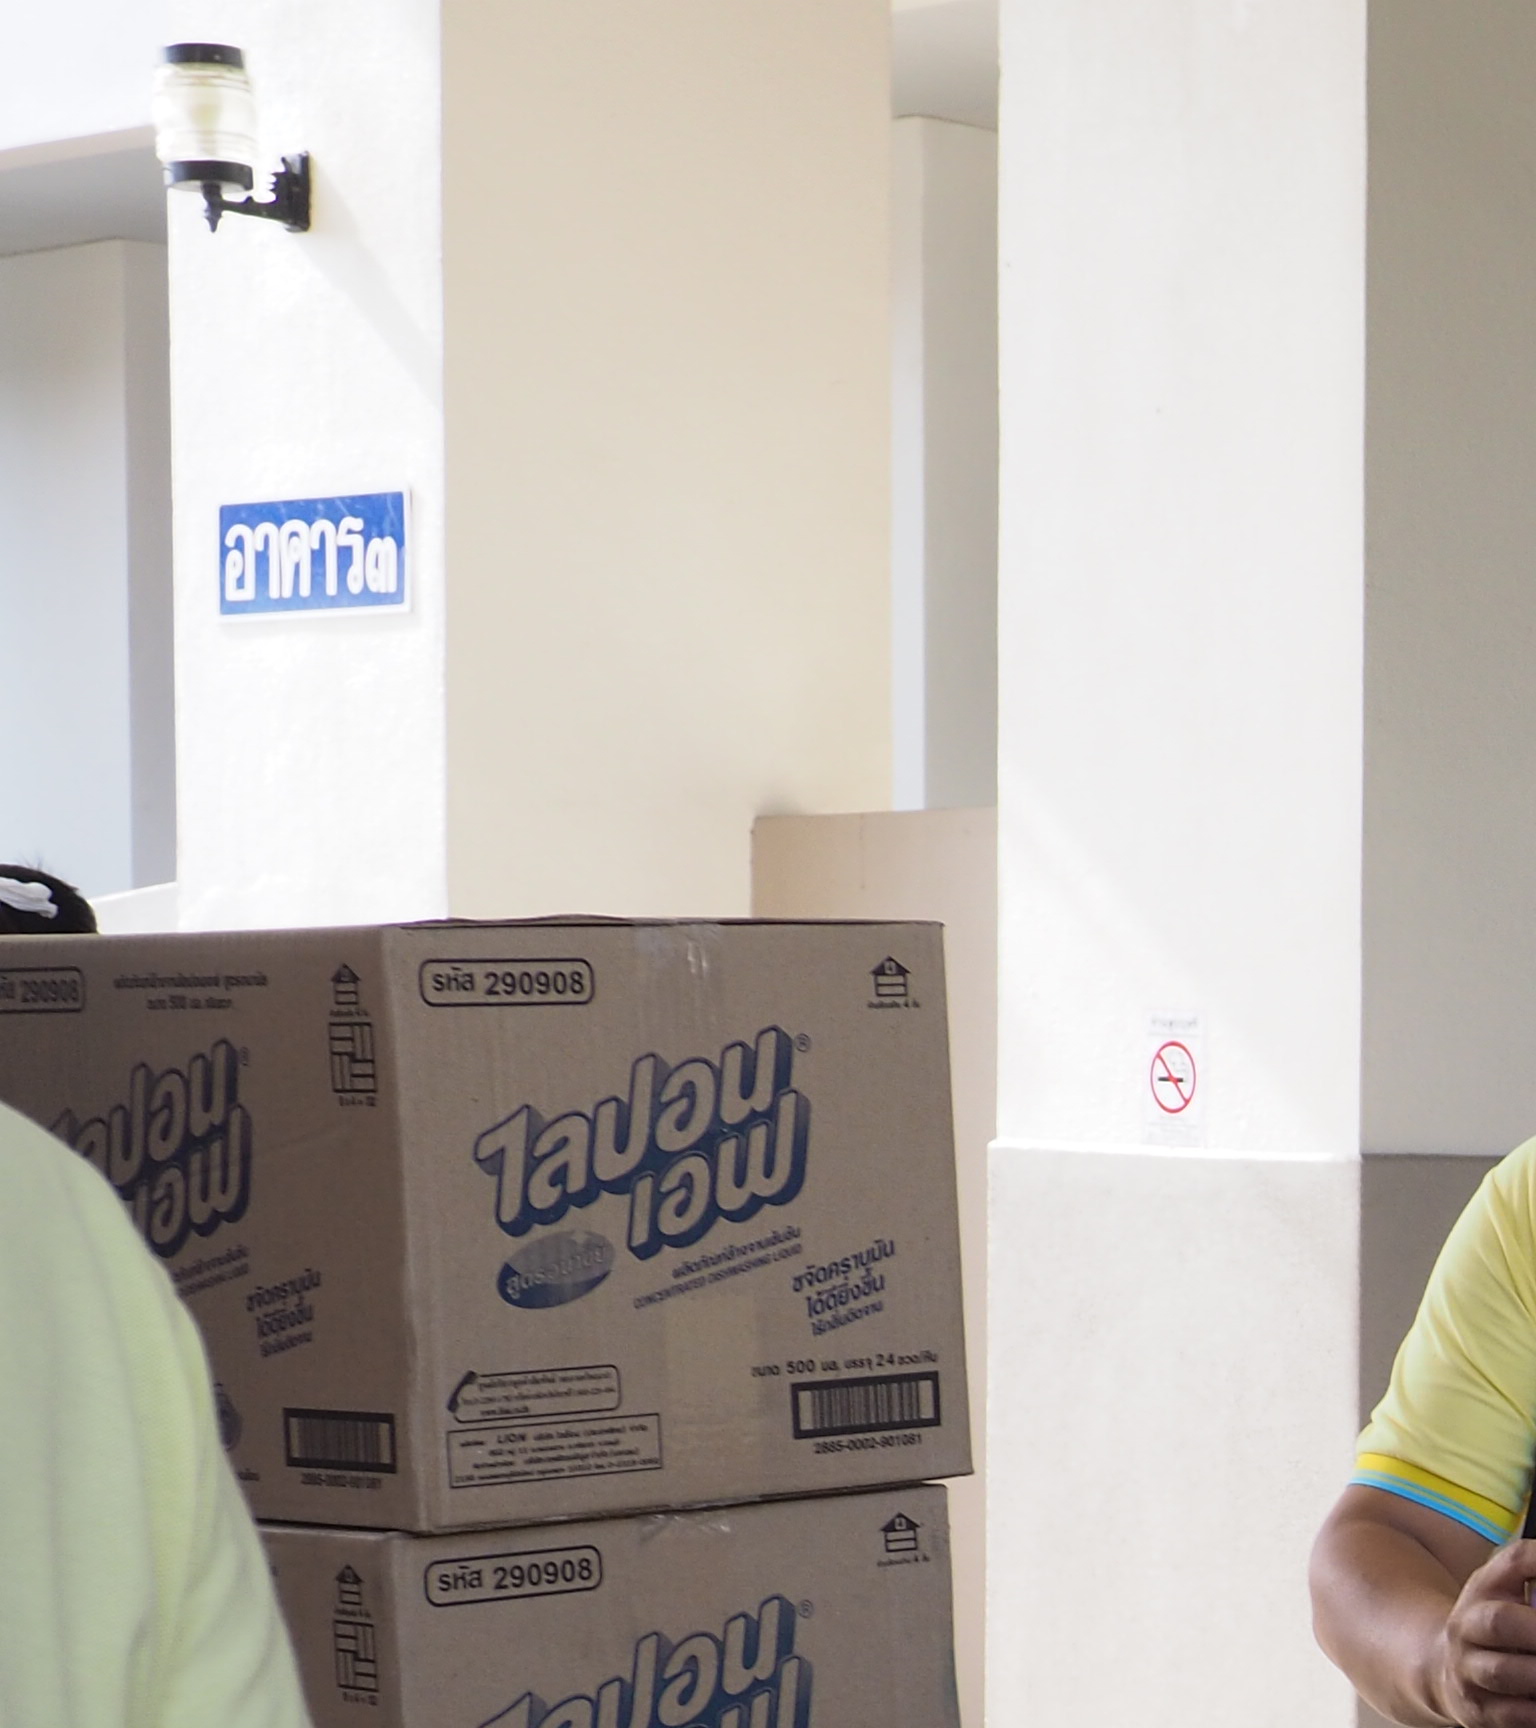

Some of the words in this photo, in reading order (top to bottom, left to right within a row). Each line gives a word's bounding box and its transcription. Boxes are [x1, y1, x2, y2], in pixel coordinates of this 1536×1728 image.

[223, 516, 398, 600] อาคาร๓
[432, 967, 475, 994] รหัส
[485, 971, 585, 997] 290908
[475, 1025, 792, 1237] ไลปอน
[628, 1088, 811, 1260] เอฟ
[786, 1357, 816, 1375] 500
[876, 1352, 895, 1367] 24
[438, 1564, 483, 1593] รหัส
[494, 1558, 593, 1591] 290908
